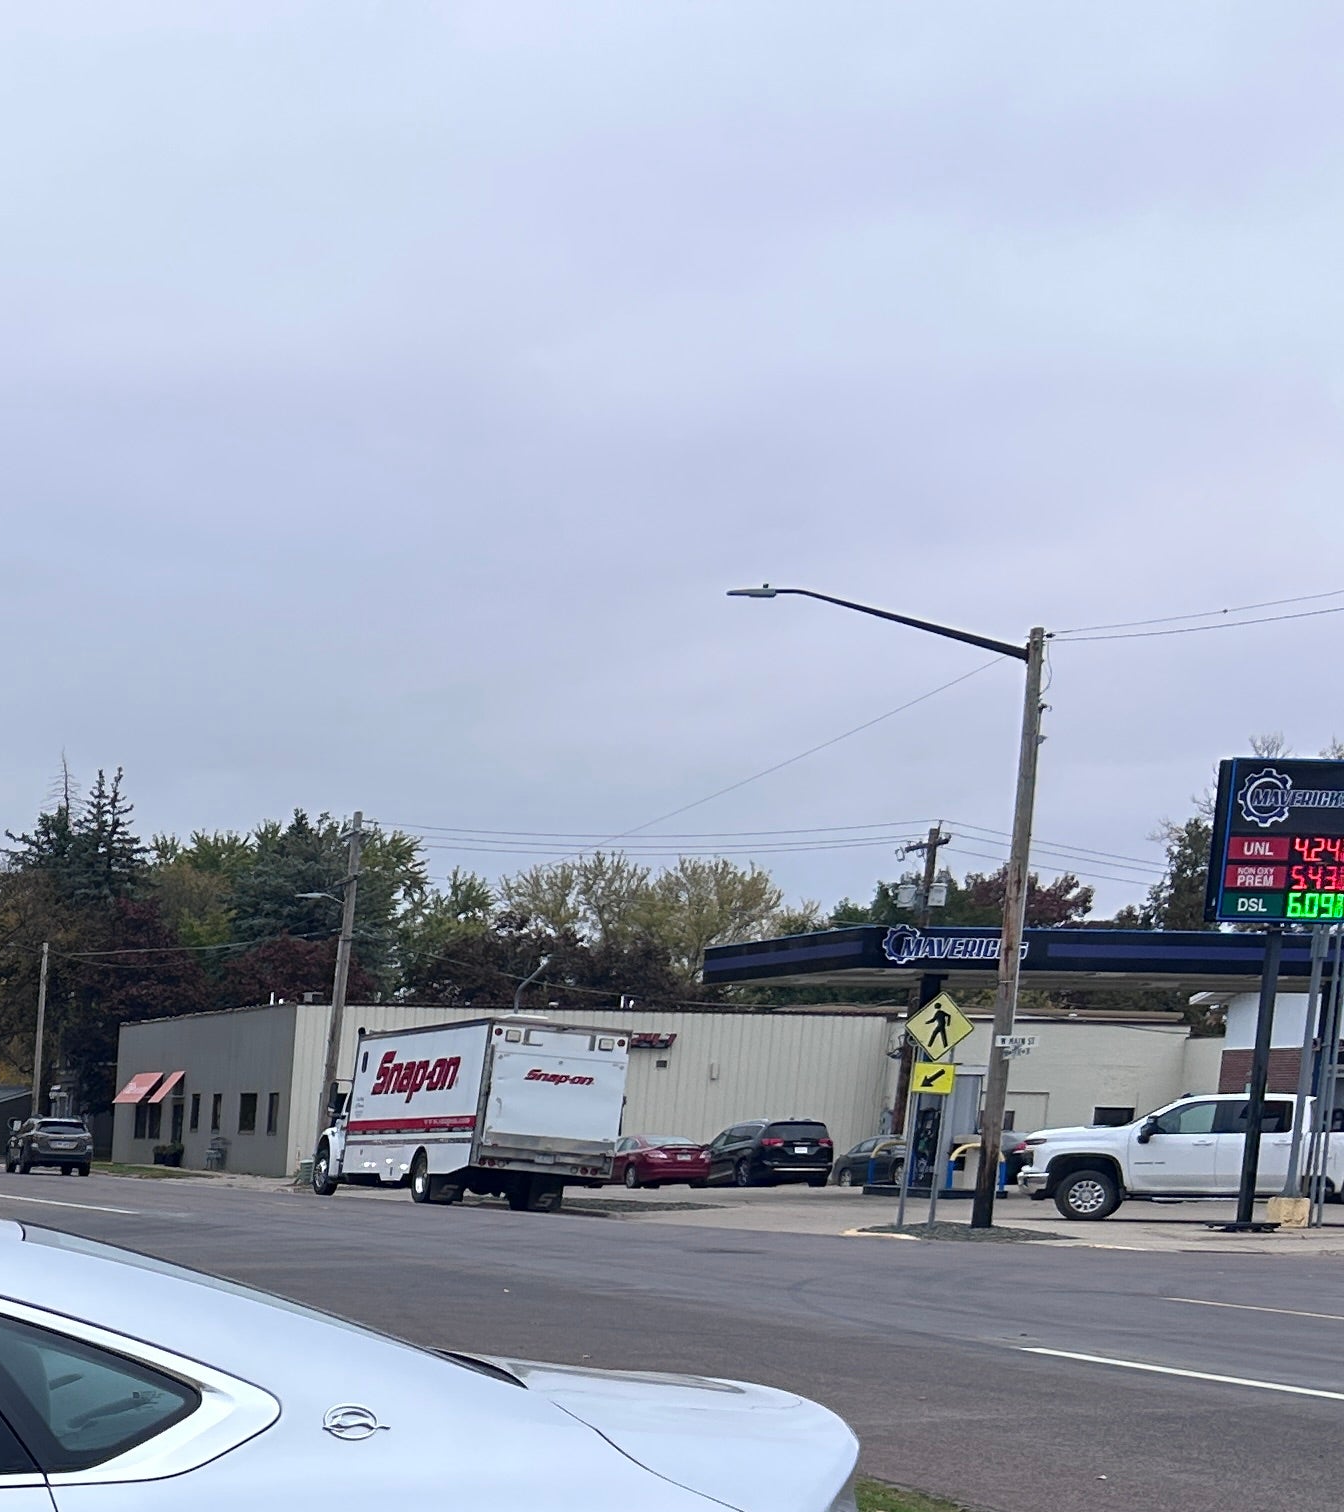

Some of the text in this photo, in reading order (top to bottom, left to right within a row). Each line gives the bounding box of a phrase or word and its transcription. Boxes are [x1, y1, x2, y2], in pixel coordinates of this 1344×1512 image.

[1243, 842, 1274, 856] UNL
[1237, 867, 1275, 875] NON OXY
[1236, 875, 1274, 887] PREM
[1237, 898, 1268, 912] DSL
[900, 936, 1030, 960] MAVERICS
[371, 1050, 461, 1104] Snap-on
[524, 1069, 594, 1086] Snap-on
